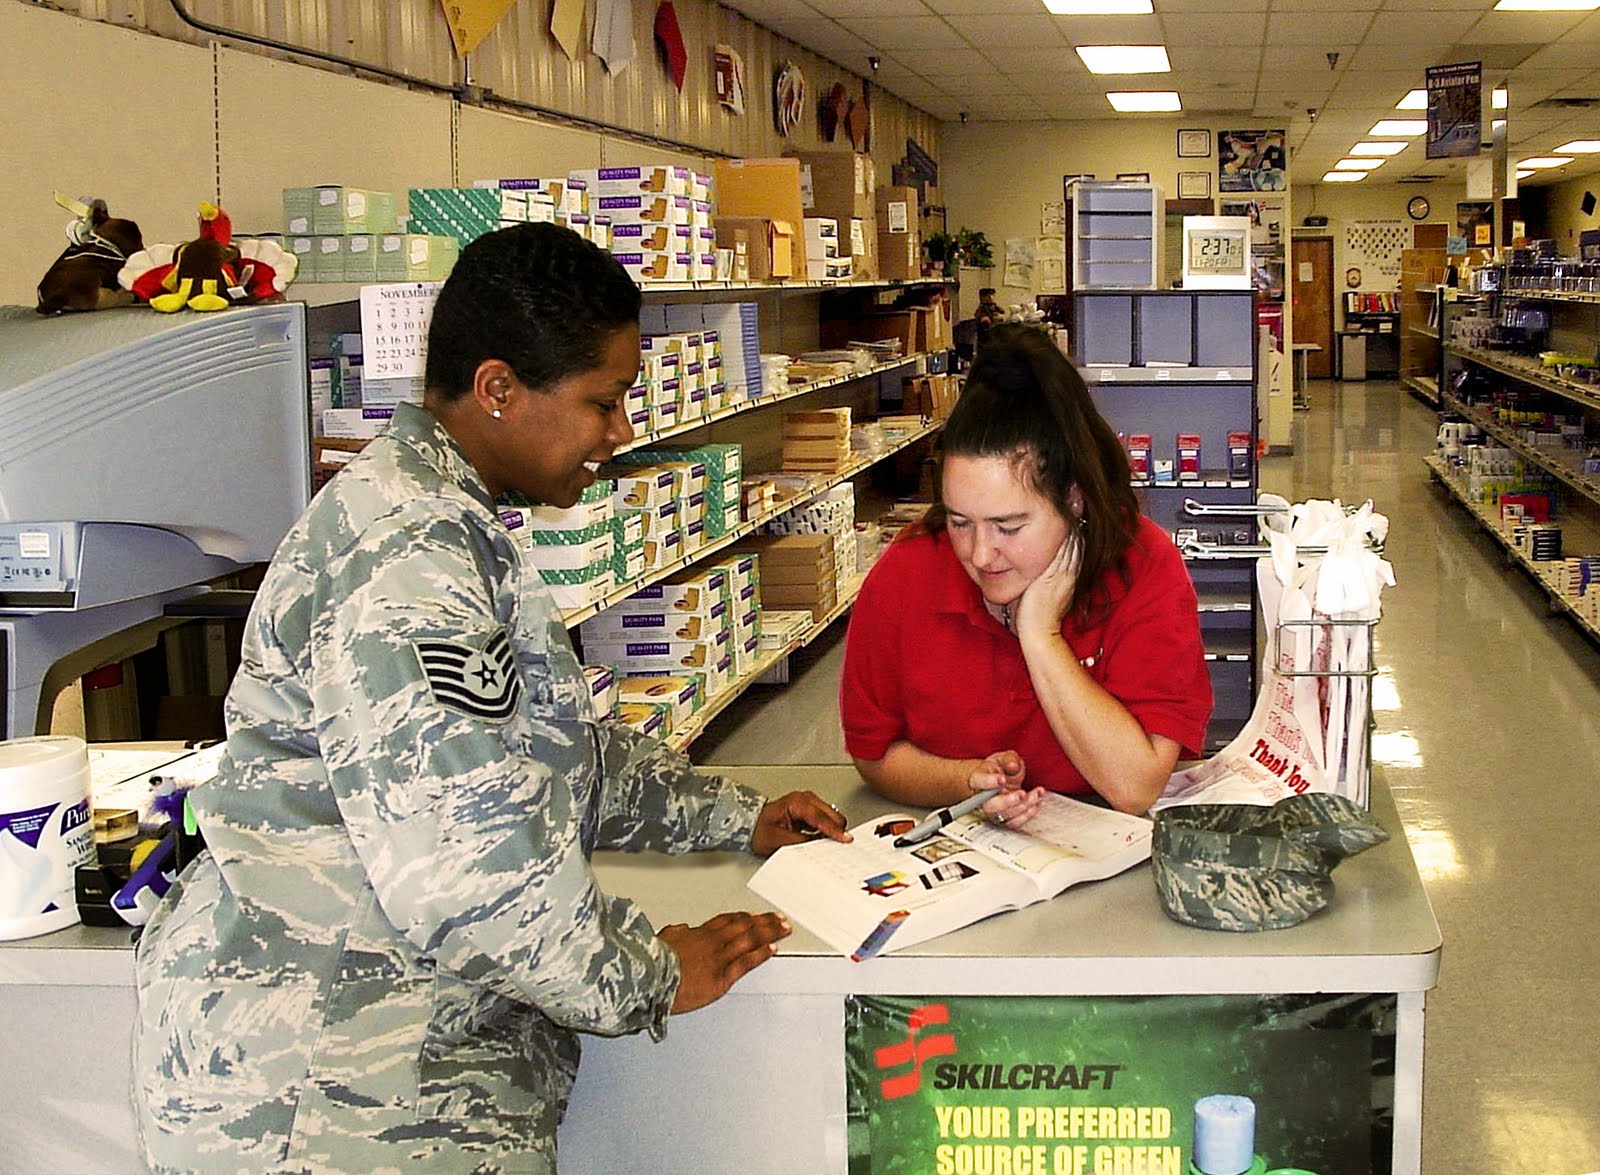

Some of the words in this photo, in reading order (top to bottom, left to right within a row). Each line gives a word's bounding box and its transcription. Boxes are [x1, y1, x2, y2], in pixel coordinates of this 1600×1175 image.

[380, 288, 435, 300] NOVEMBER
[375, 309, 381, 319] 1
[391, 307, 397, 318] 2
[405, 307, 411, 317] 3
[420, 307, 425, 315] 4
[377, 323, 383, 332] 8
[391, 322, 398, 331] 9
[404, 321, 415, 330] 10
[418, 320, 428, 329] 11
[375, 336, 386, 345] 15
[390, 335, 401, 344] 16
[404, 334, 415, 343] 17
[376, 349, 387, 359] 22
[390, 348, 401, 359] 23
[405, 348, 416, 358] 24
[376, 362, 388, 373] 29
[393, 363, 403, 372] 30
[1249, 739, 1289, 778] Thank
[1283, 764, 1310, 795] You
[933, 1063, 1121, 1090] SKILCRAFT
[935, 1106, 1011, 1138] YOUR
[1017, 1106, 1172, 1139] PREFERRED
[936, 1145, 1047, 1175] SOURCE
[1053, 1145, 1088, 1175] OF
[1094, 1145, 1182, 1175] GREEN
